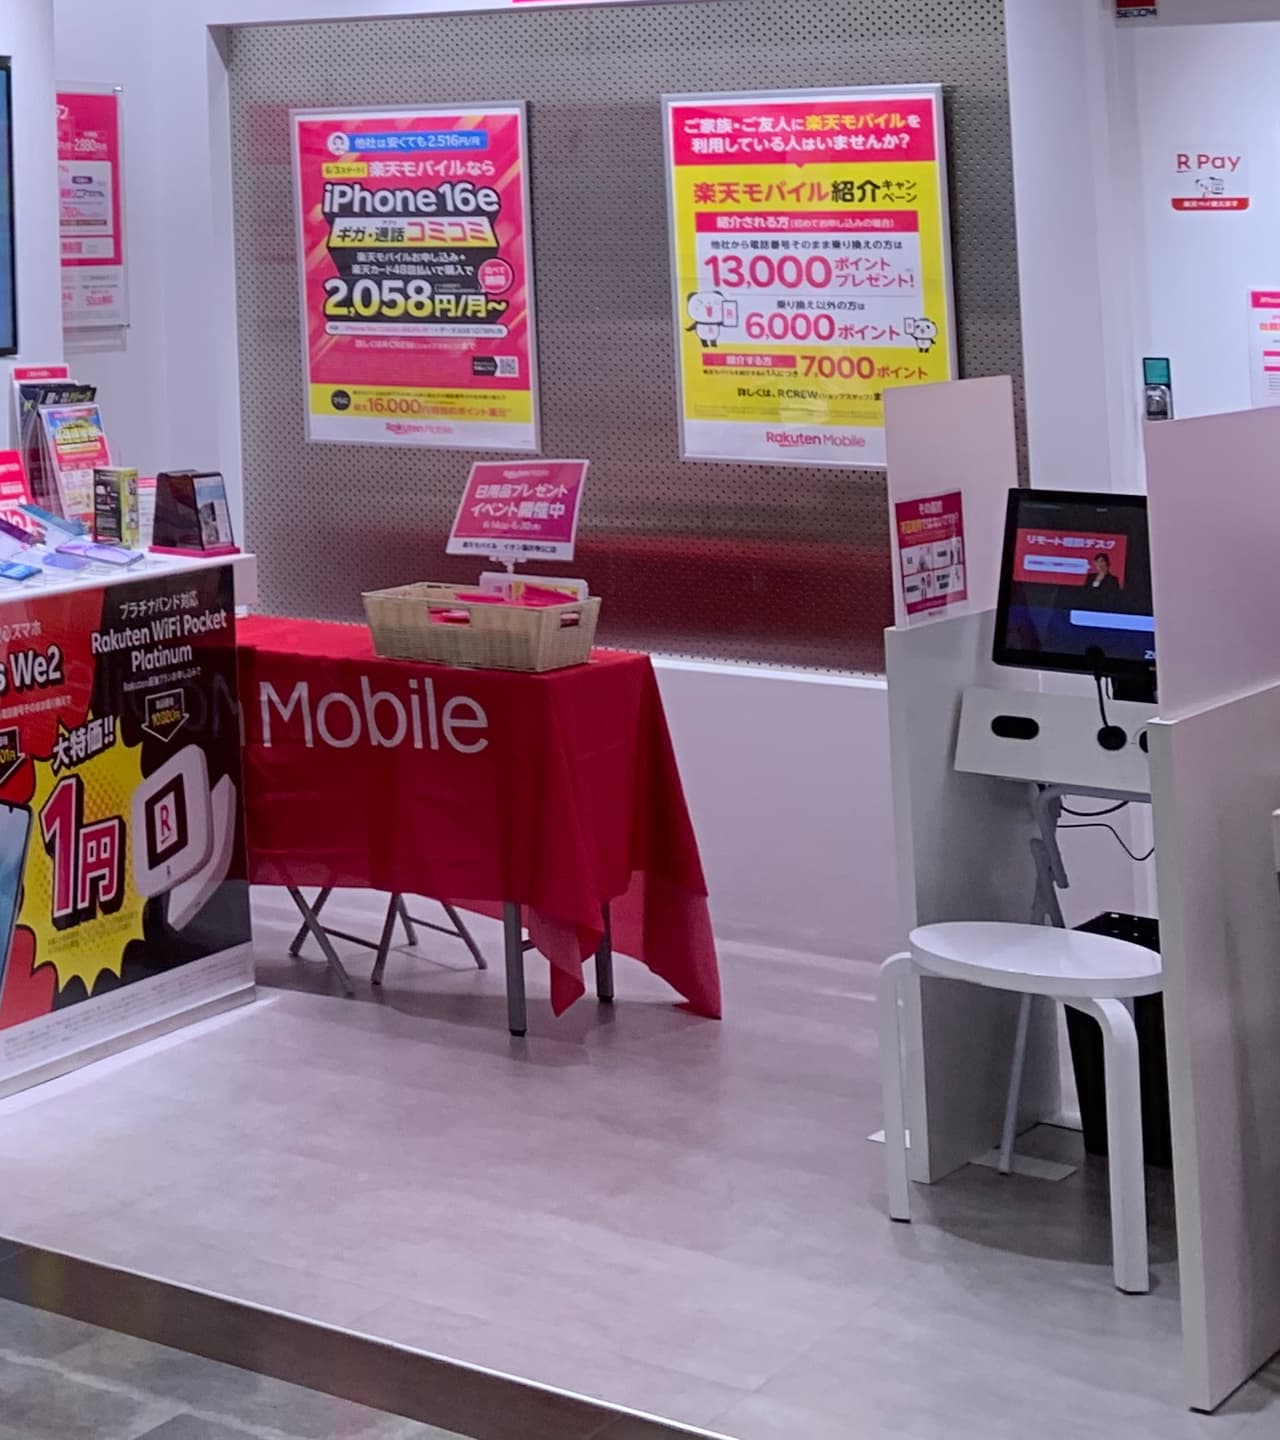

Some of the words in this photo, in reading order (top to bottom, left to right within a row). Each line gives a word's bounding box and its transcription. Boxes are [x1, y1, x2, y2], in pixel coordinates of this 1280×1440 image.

[684, 112, 921, 135] ご家族・ご友人に楽天モバイルを
[691, 133, 910, 154] 利用している人はいませんか?
[369, 160, 495, 177] 楽天モバイルなら
[1176, 154, 1192, 173] R
[1197, 154, 1241, 173] Pay
[323, 183, 437, 213] iPhone
[438, 182, 500, 213] 16e
[704, 254, 833, 289] 13,000
[835, 257, 891, 271] ポイント
[835, 273, 915, 288] プレゼント!
[776, 300, 866, 311] 乗り換え以外の方は
[745, 312, 835, 341] 6,000
[838, 324, 901, 340] ポイント
[800, 355, 875, 380] 7,000
[877, 366, 928, 379] ポイント
[766, 431, 822, 448] Rakuten
[823, 434, 865, 448] Mobile
[120, 590, 199, 620] プラチナバンド対応
[91, 627, 150, 655] Rakuten
[151, 615, 181, 642] WiFi
[183, 608, 227, 636] Pocket
[9, 644, 62, 689] We2
[131, 644, 193, 673] Platinum
[259, 675, 489, 754] Mobile
